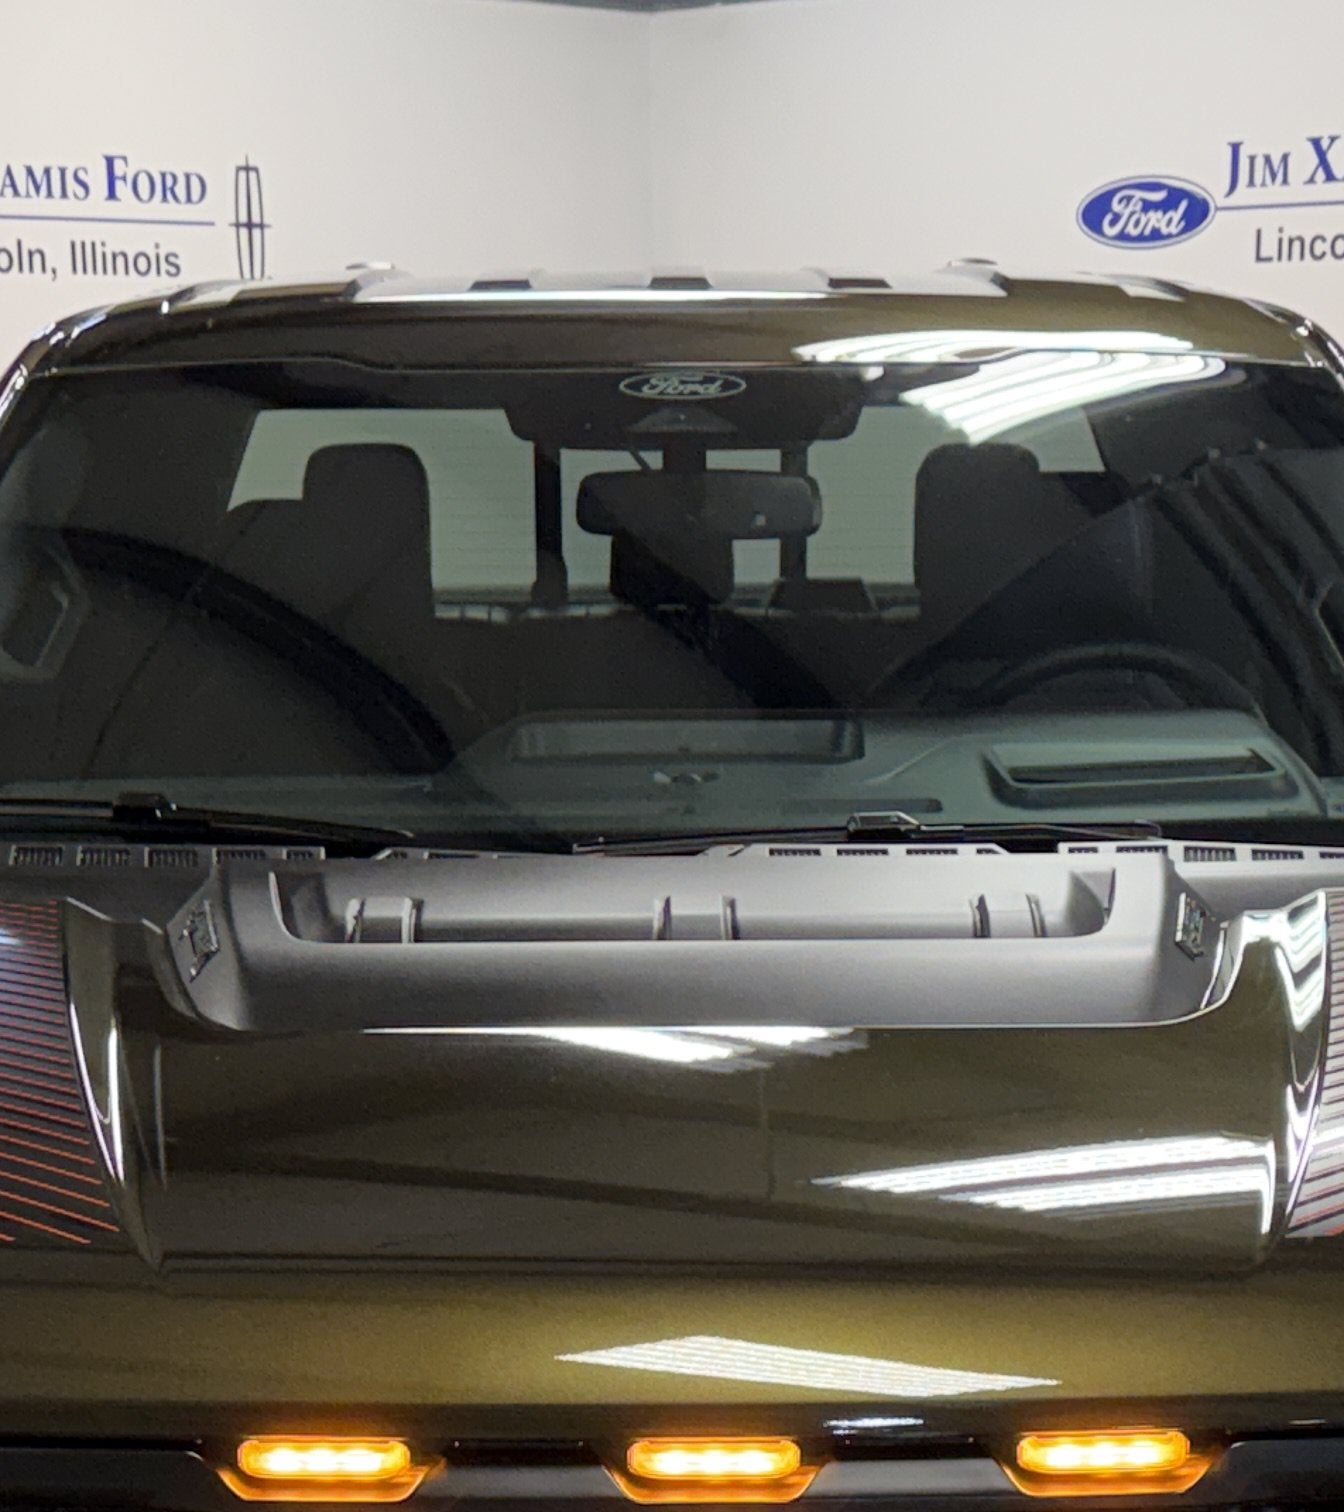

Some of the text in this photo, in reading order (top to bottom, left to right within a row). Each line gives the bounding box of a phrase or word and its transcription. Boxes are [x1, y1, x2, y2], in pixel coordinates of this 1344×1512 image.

[102, 154, 208, 205] FORD
[1223, 139, 1291, 199] JIM
[1101, 188, 1189, 237] Ford
[69, 239, 183, 279] Illinois
[640, 373, 724, 396] Ford
